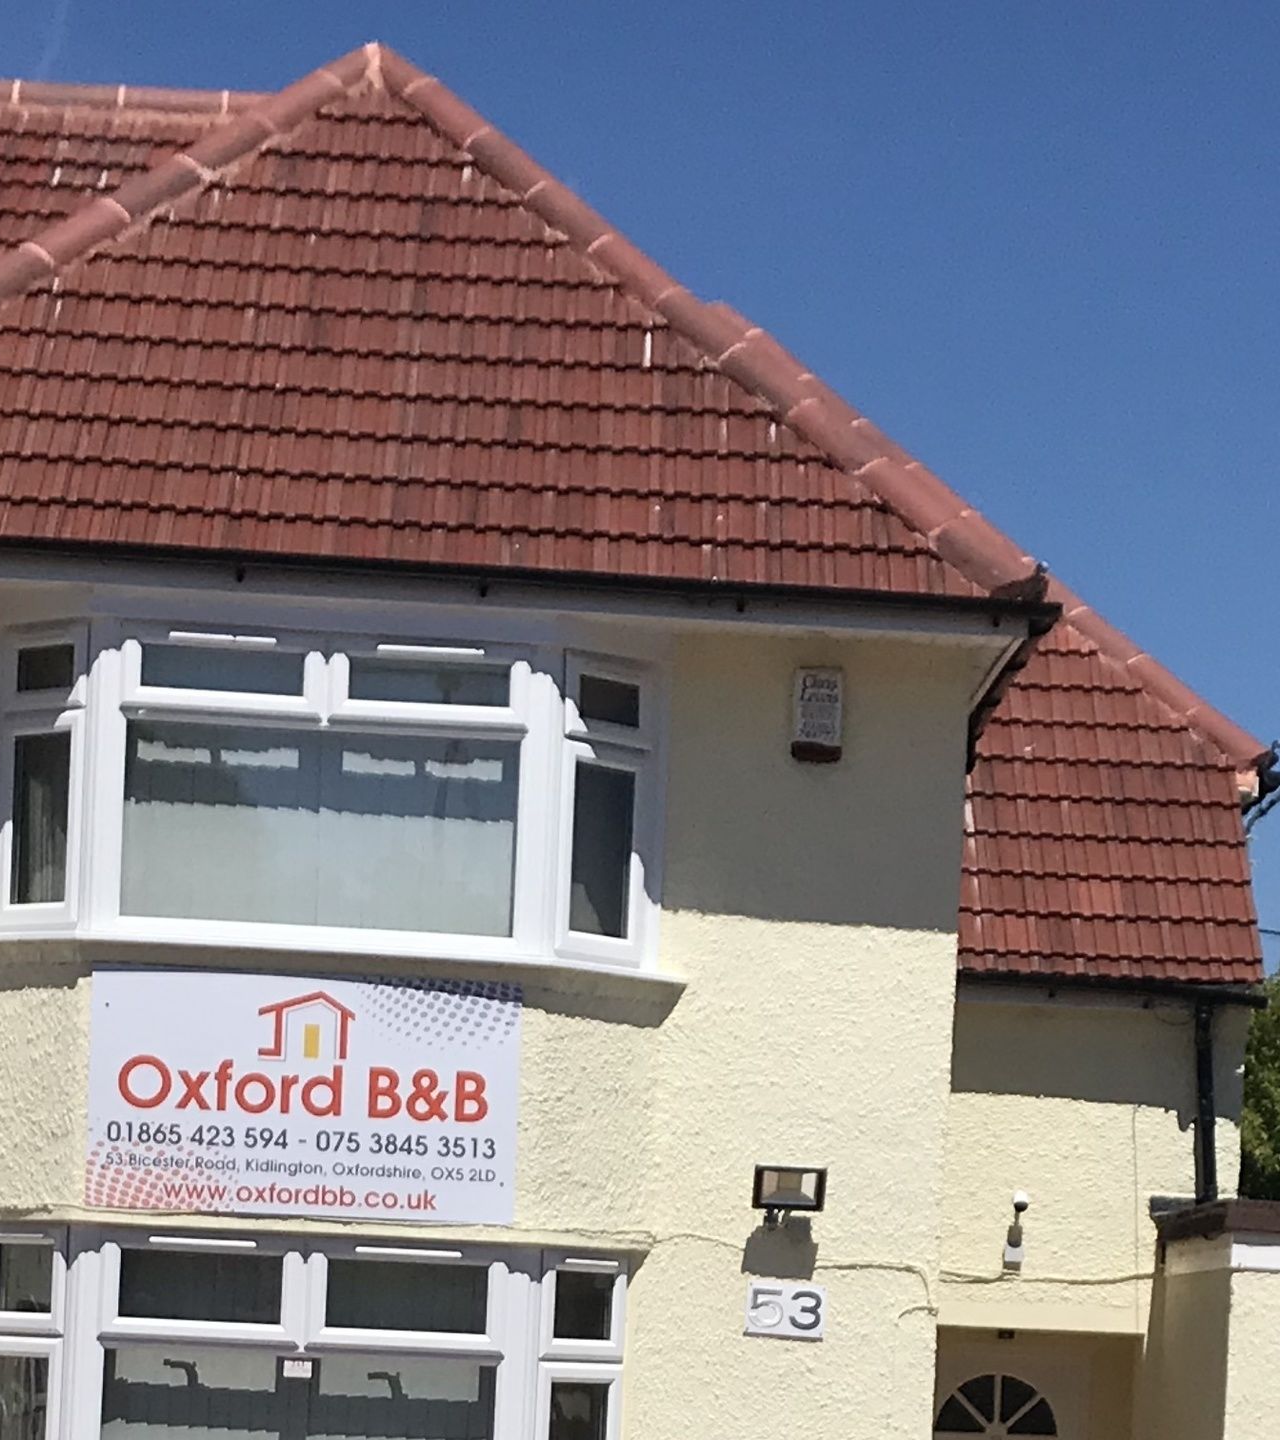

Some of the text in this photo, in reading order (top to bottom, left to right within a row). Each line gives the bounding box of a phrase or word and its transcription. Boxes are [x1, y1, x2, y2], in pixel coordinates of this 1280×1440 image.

[117, 1054, 488, 1122] Oxford B&B
[107, 1121, 182, 1145] 01865
[190, 1125, 235, 1147] 423
[244, 1127, 288, 1150] 594
[316, 1130, 360, 1153] 075
[369, 1132, 428, 1156] 3845
[437, 1135, 496, 1159] 3513
[106, 1152, 496, 1182] 53 Bicester Road, Kidlington, Oxfordshire, OX5 2LD
[748, 1288, 822, 1330] 53
